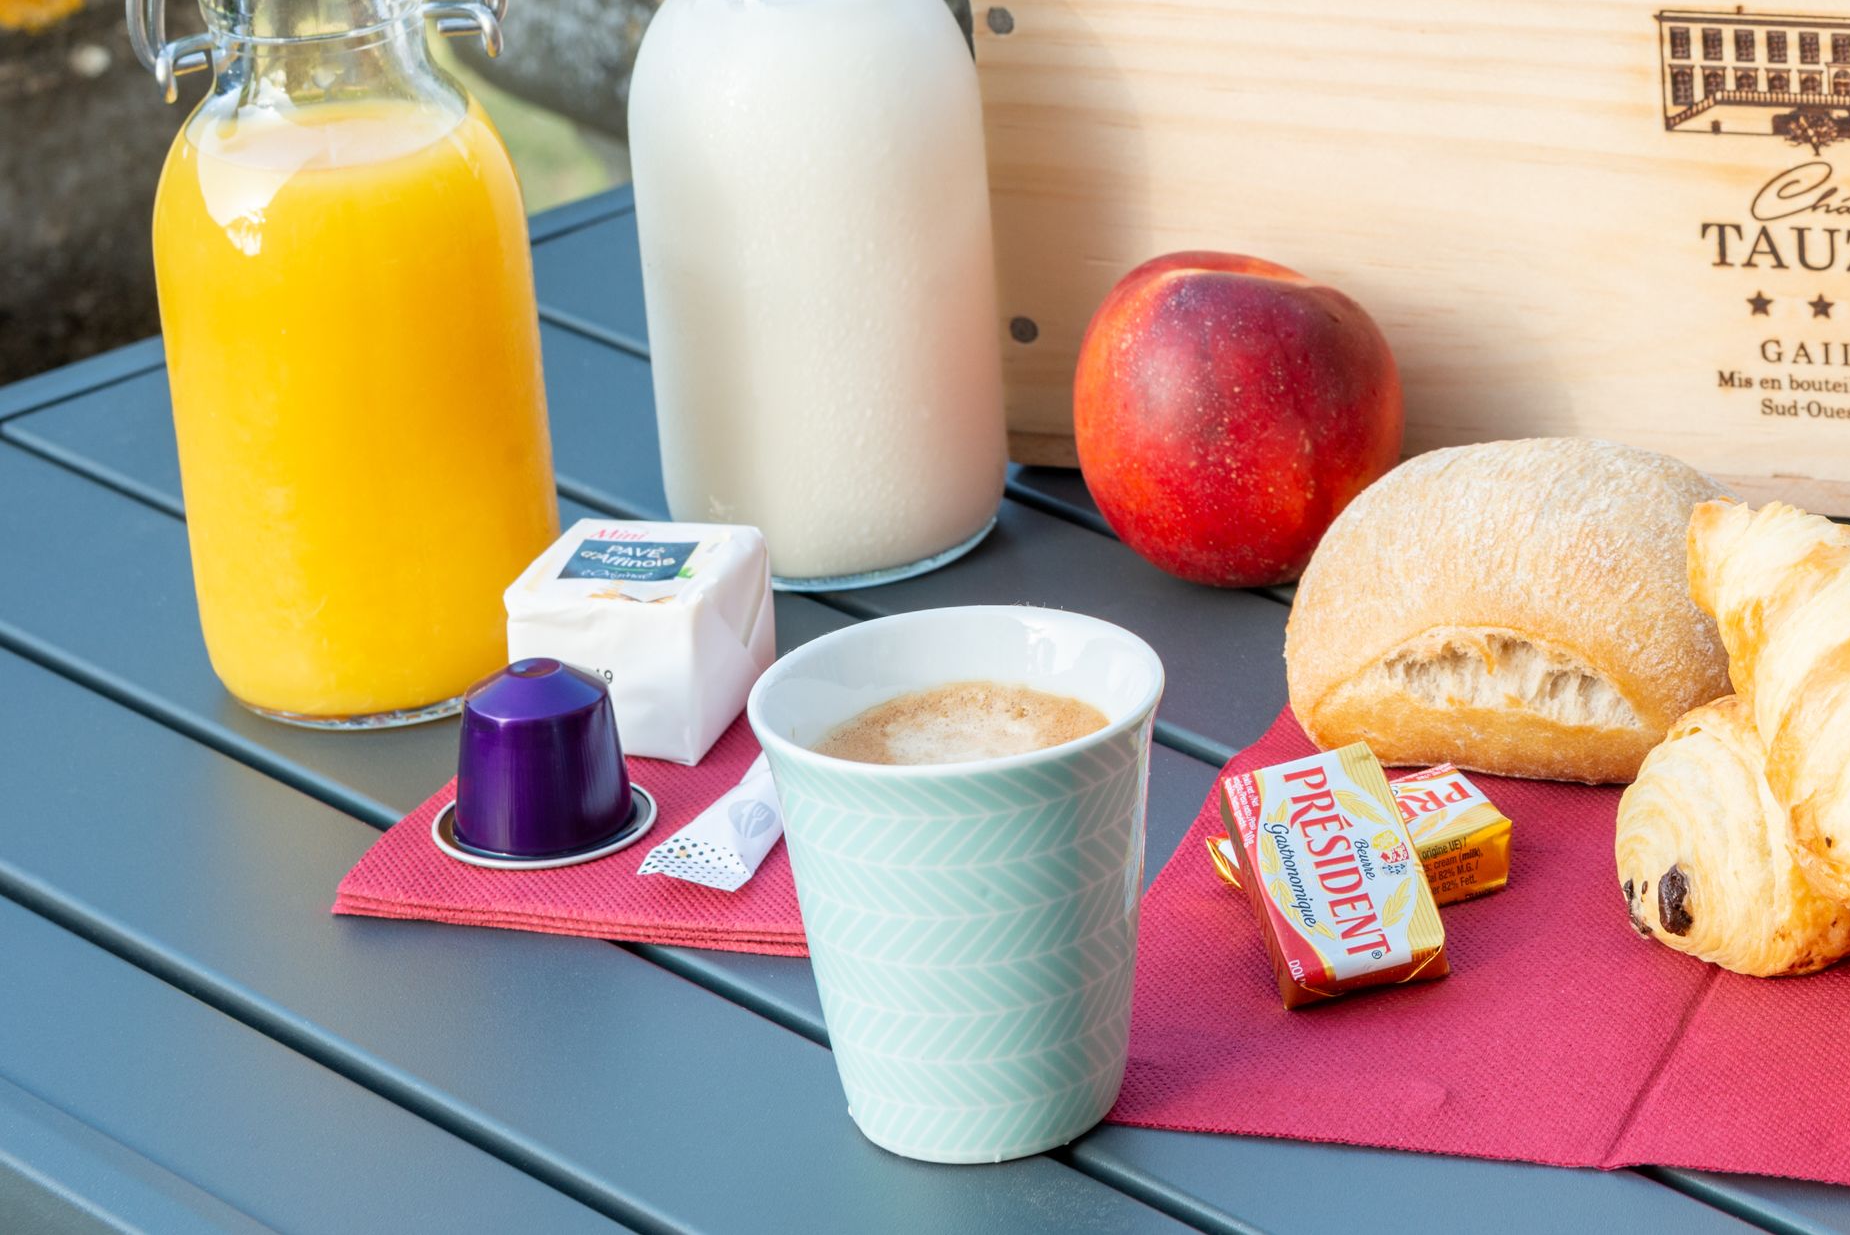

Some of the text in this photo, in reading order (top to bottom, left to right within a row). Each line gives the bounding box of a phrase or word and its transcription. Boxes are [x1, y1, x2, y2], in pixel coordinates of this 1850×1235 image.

[1718, 370, 1753, 390] Mis
[1759, 377, 1782, 390] en
[1354, 838, 1377, 882] Beurre
[1421, 843, 1449, 861] origine
[1433, 856, 1457, 870] cream
[1263, 821, 1317, 929] Gastronomique
